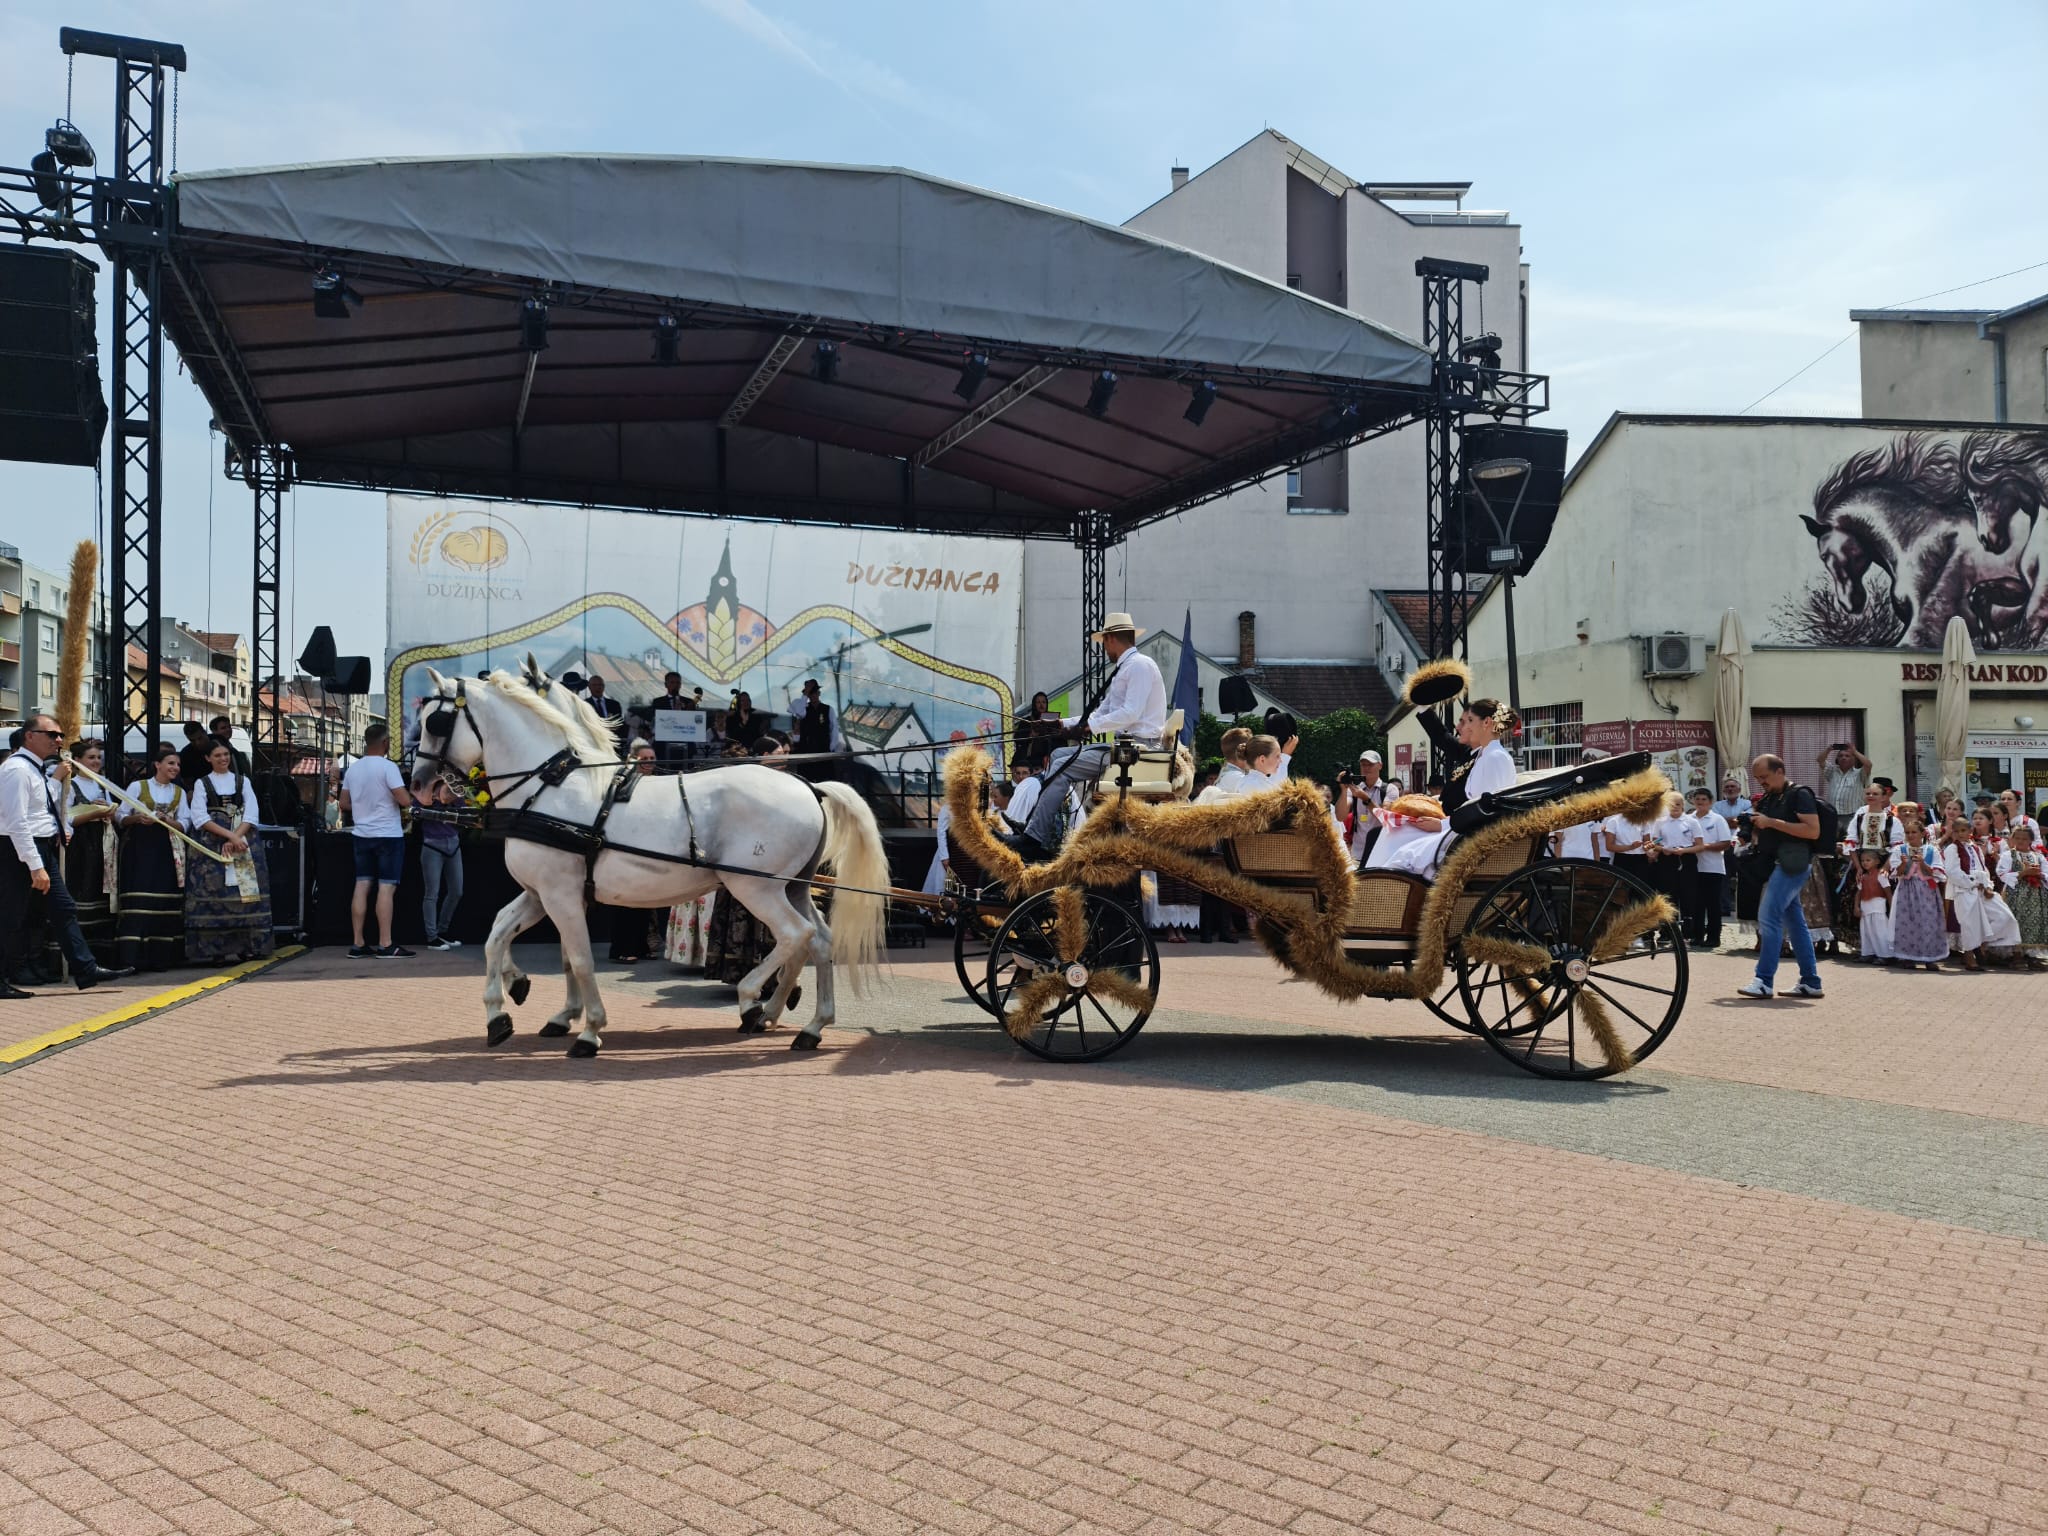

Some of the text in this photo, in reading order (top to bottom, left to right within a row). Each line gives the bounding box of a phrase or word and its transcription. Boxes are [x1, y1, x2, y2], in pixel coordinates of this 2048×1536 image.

[846, 560, 1000, 596] DUŽIJANCA
[427, 582, 523, 602] DUŽIJANCA
[2006, 664, 2048, 683] KOD
[1639, 729, 1710, 738] KOD SERVALA
